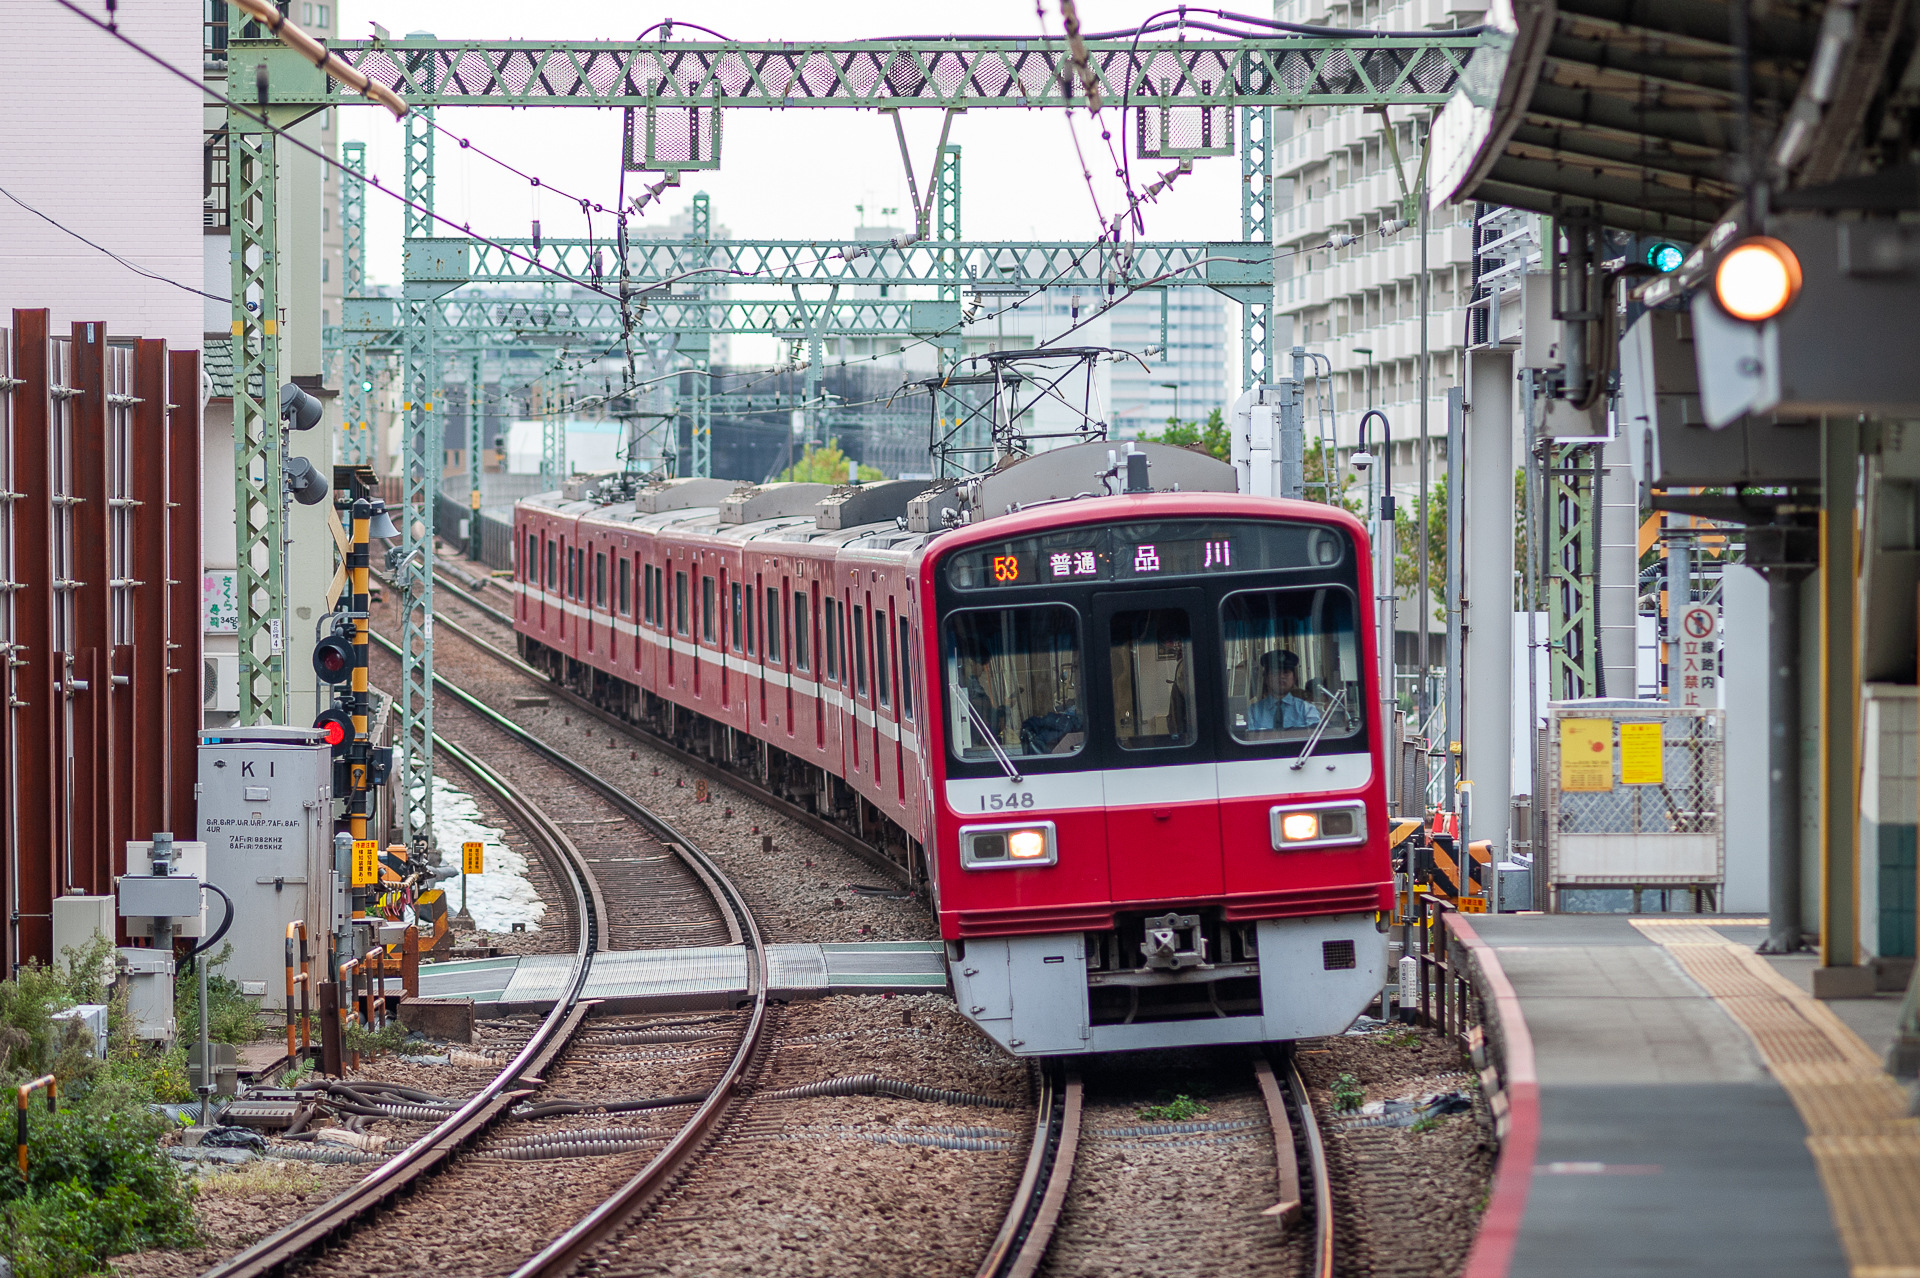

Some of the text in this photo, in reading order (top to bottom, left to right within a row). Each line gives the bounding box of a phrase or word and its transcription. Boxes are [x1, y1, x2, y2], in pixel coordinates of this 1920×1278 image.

[993, 540, 1231, 581] 53 普通 品川
[223, 575, 233, 611] さくら
[1683, 641, 1699, 706] 立入禁止
[1701, 641, 1715, 689] 線路内
[241, 761, 255, 777] K
[980, 792, 1035, 811] 1548
